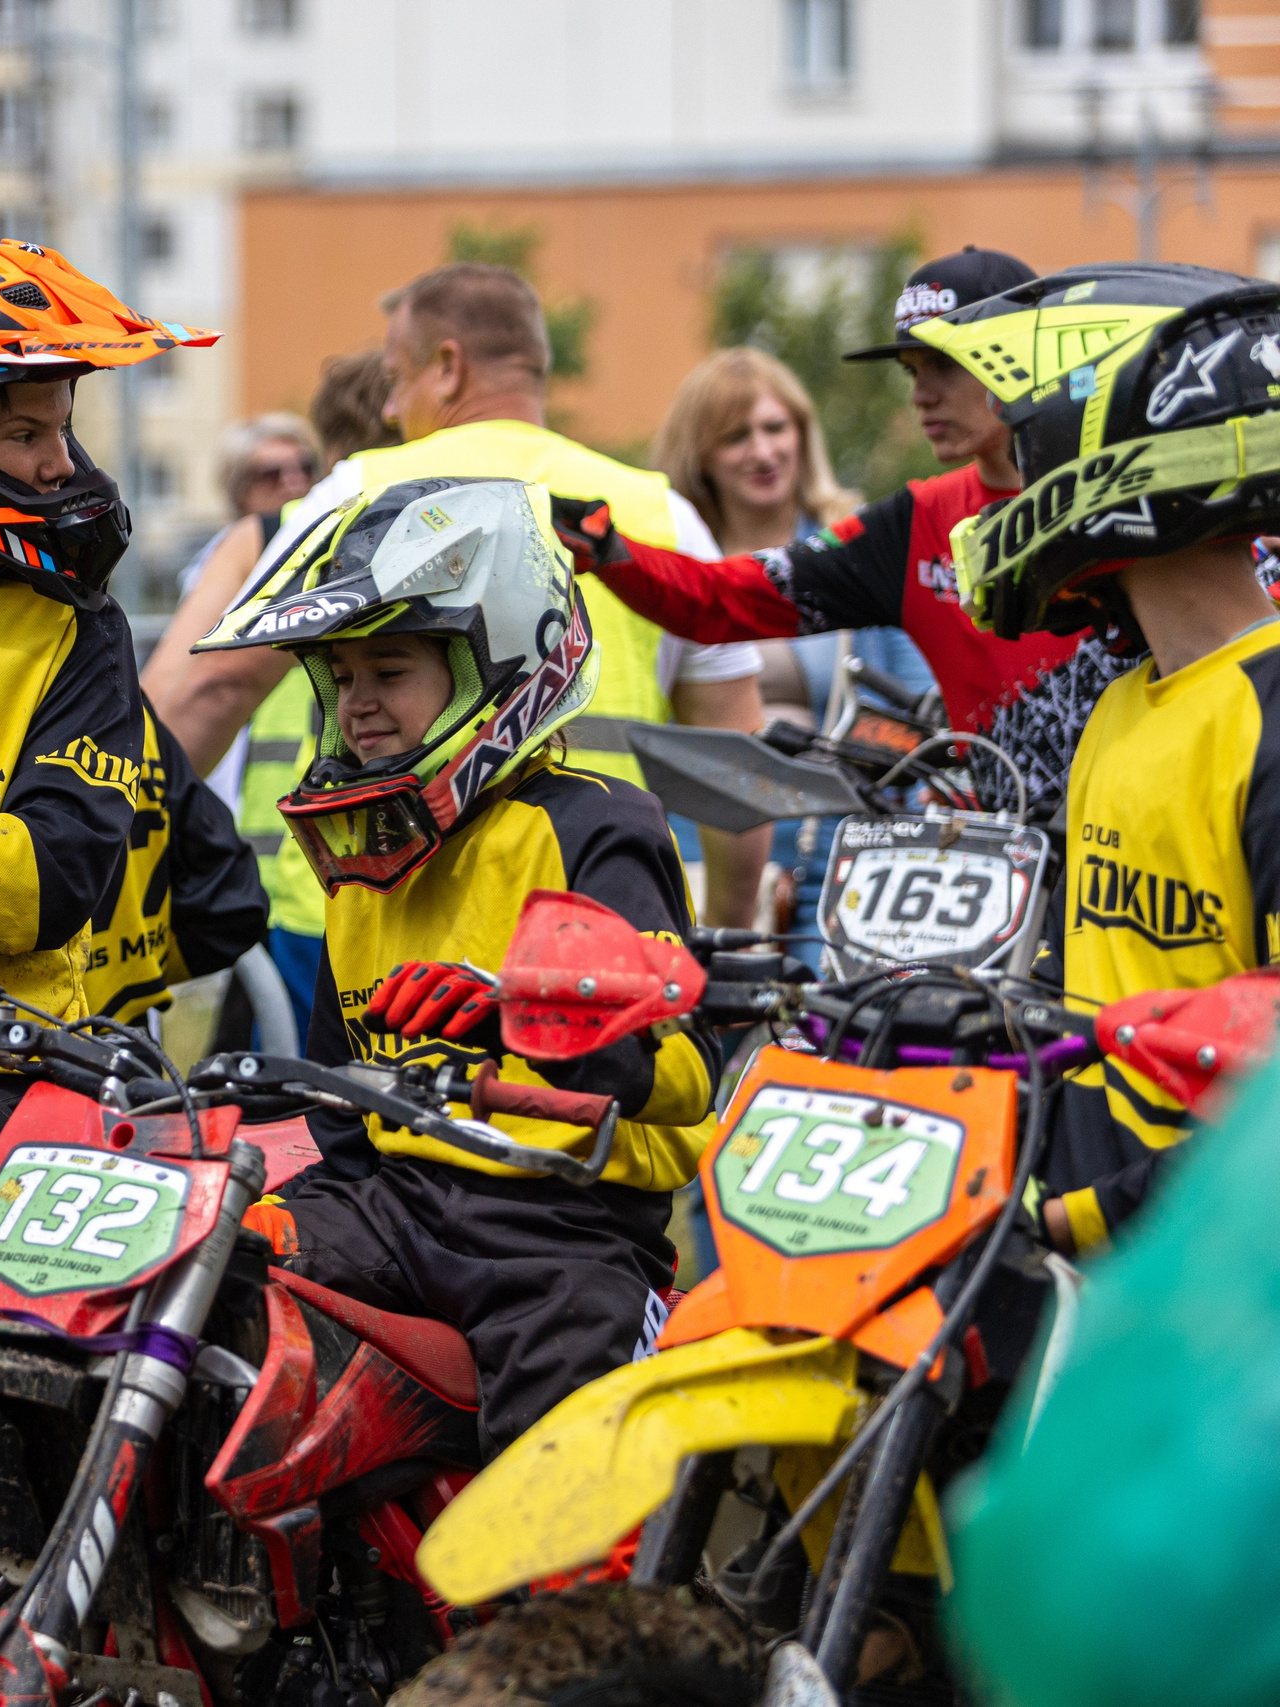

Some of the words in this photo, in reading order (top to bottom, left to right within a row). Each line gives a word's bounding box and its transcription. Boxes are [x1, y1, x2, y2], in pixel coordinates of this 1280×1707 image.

[23, 340, 145, 354] VERTER
[978, 442, 1155, 576] 100%
[402, 554, 443, 590] AIROH
[246, 597, 351, 638] Airoh
[860, 865, 994, 927] 163
[737, 1114, 930, 1219] 134
[26, 1271, 48, 1286] J2
[48, 1257, 102, 1275] JUNIOR
